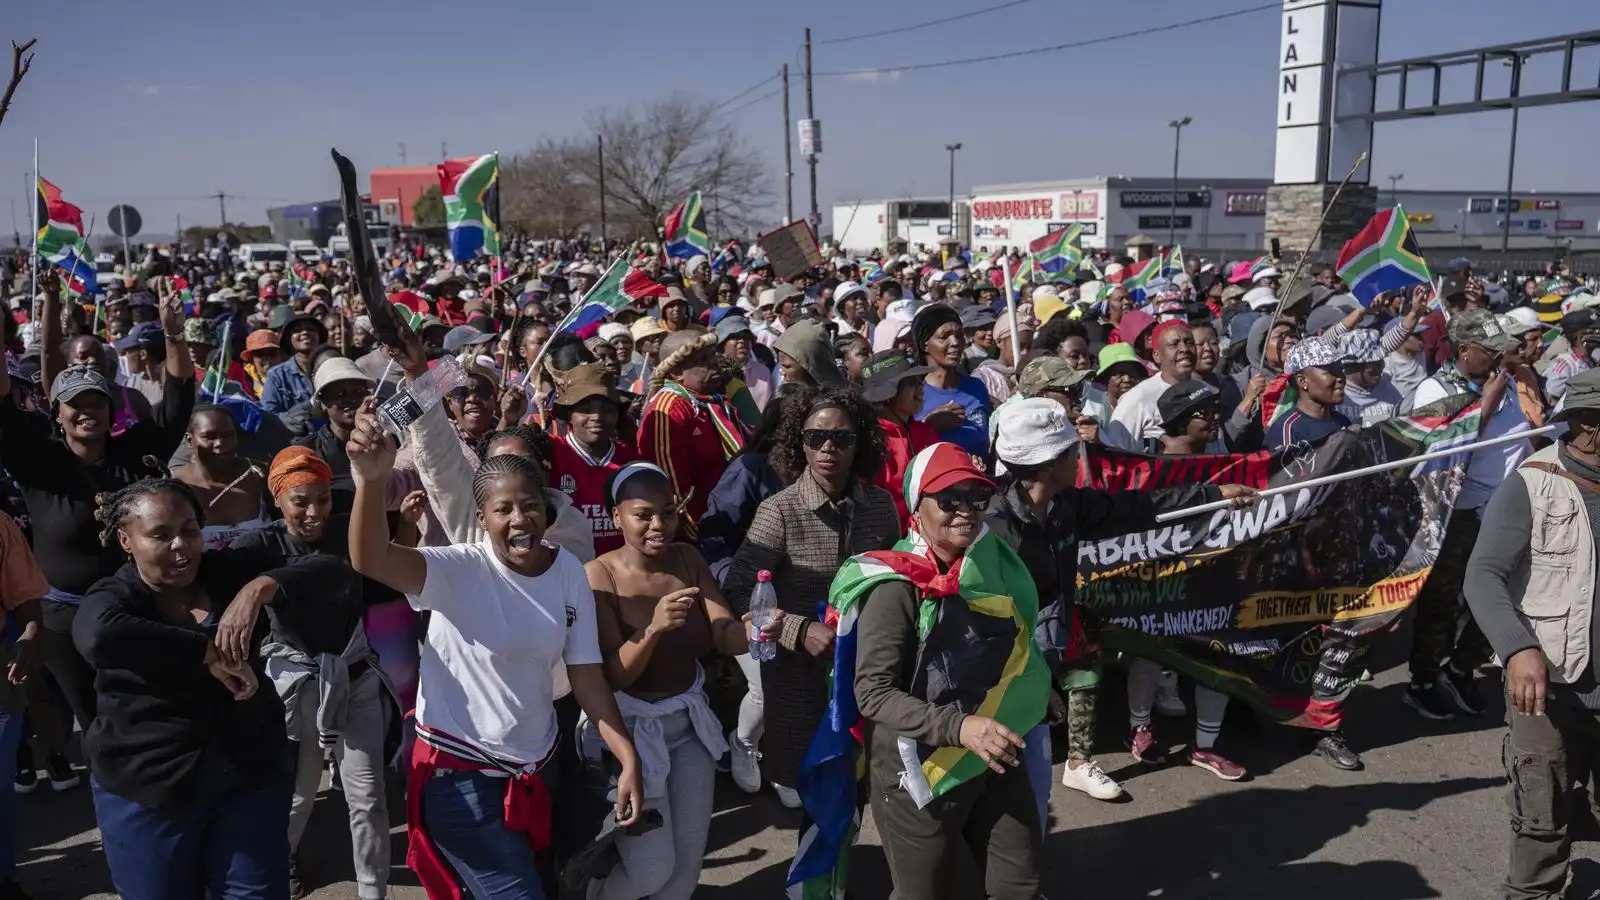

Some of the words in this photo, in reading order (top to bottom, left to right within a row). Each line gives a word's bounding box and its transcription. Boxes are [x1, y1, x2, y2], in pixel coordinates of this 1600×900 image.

[1283, 0, 1299, 121] LANI
[973, 199, 1053, 220] SHOPRITE
[388, 406, 407, 428] OWER
[1341, 403, 1395, 418] FRIENDSHI
[581, 505, 609, 517] TEA
[1256, 595, 1311, 621] TOGETHER
[1315, 593, 1338, 616] WE
